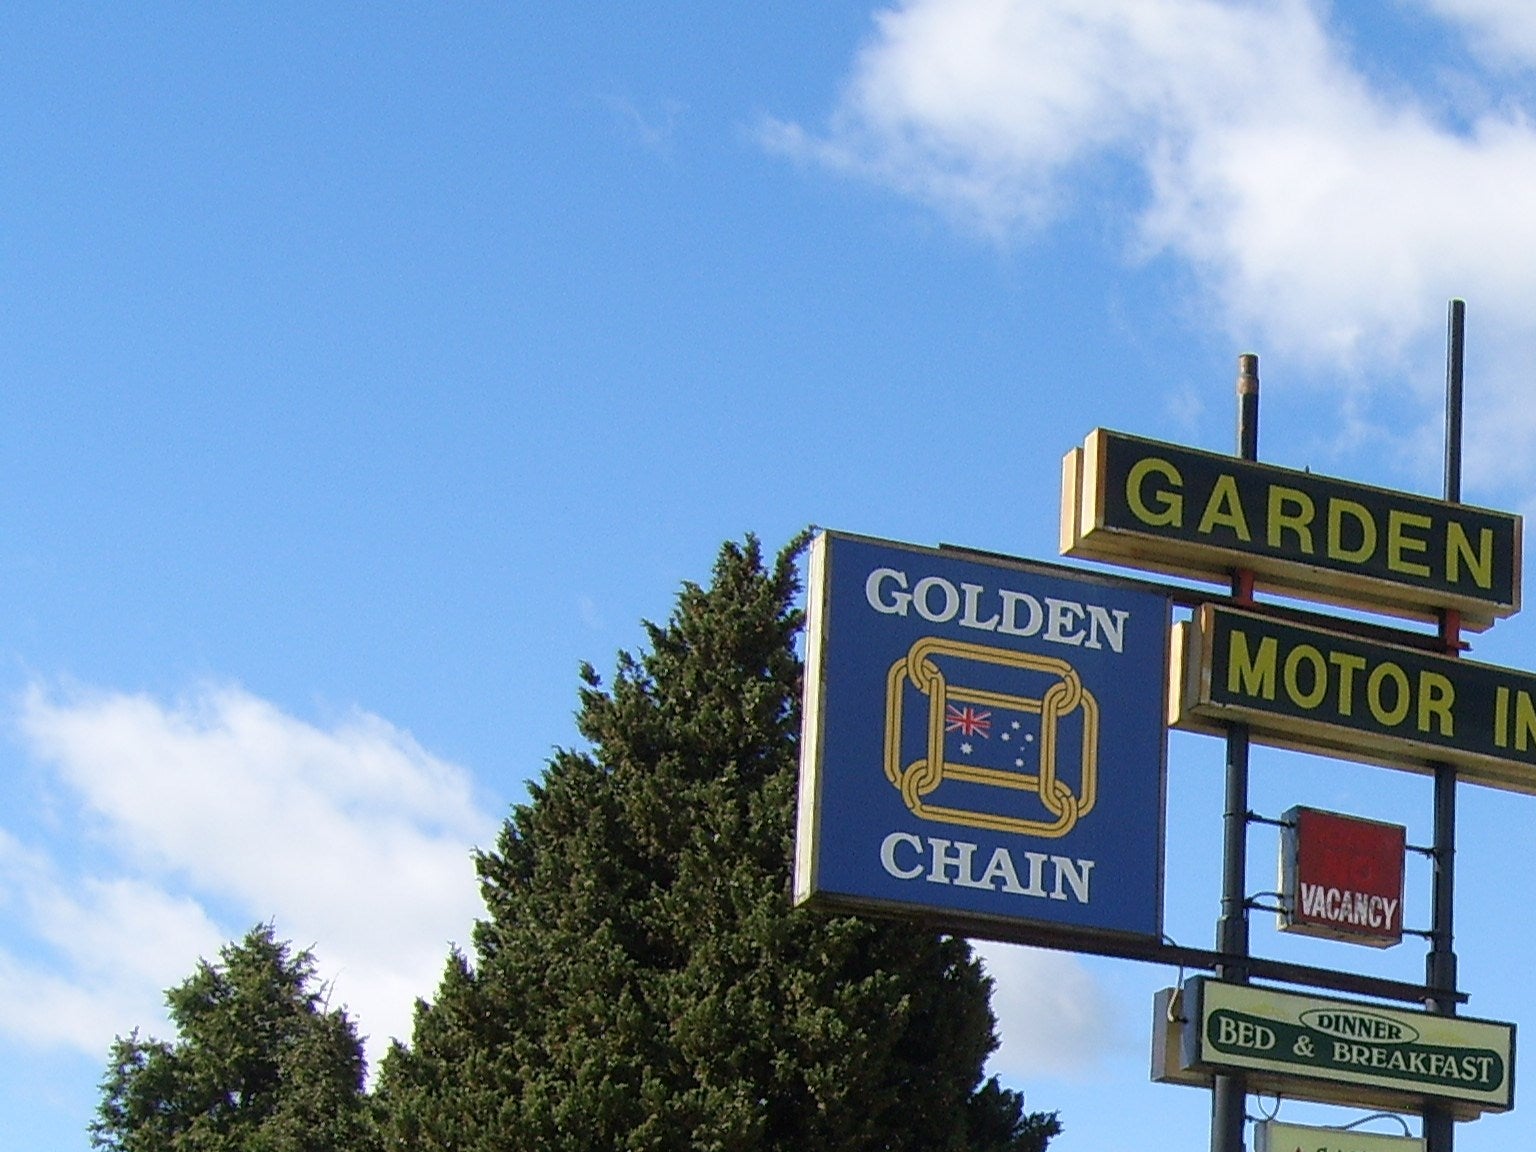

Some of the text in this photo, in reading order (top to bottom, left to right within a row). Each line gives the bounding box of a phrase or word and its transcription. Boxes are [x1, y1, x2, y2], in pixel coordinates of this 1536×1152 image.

[1124, 457, 1495, 590] GARDEN
[865, 566, 1130, 655] GOLDEN
[1227, 629, 1455, 738] MOTOR
[880, 833, 1095, 905] CHAIN
[1300, 882, 1398, 931] VACANCY
[1218, 1017, 1494, 1084] BED & BREAKFAST
[1317, 1013, 1404, 1041] DINNER
